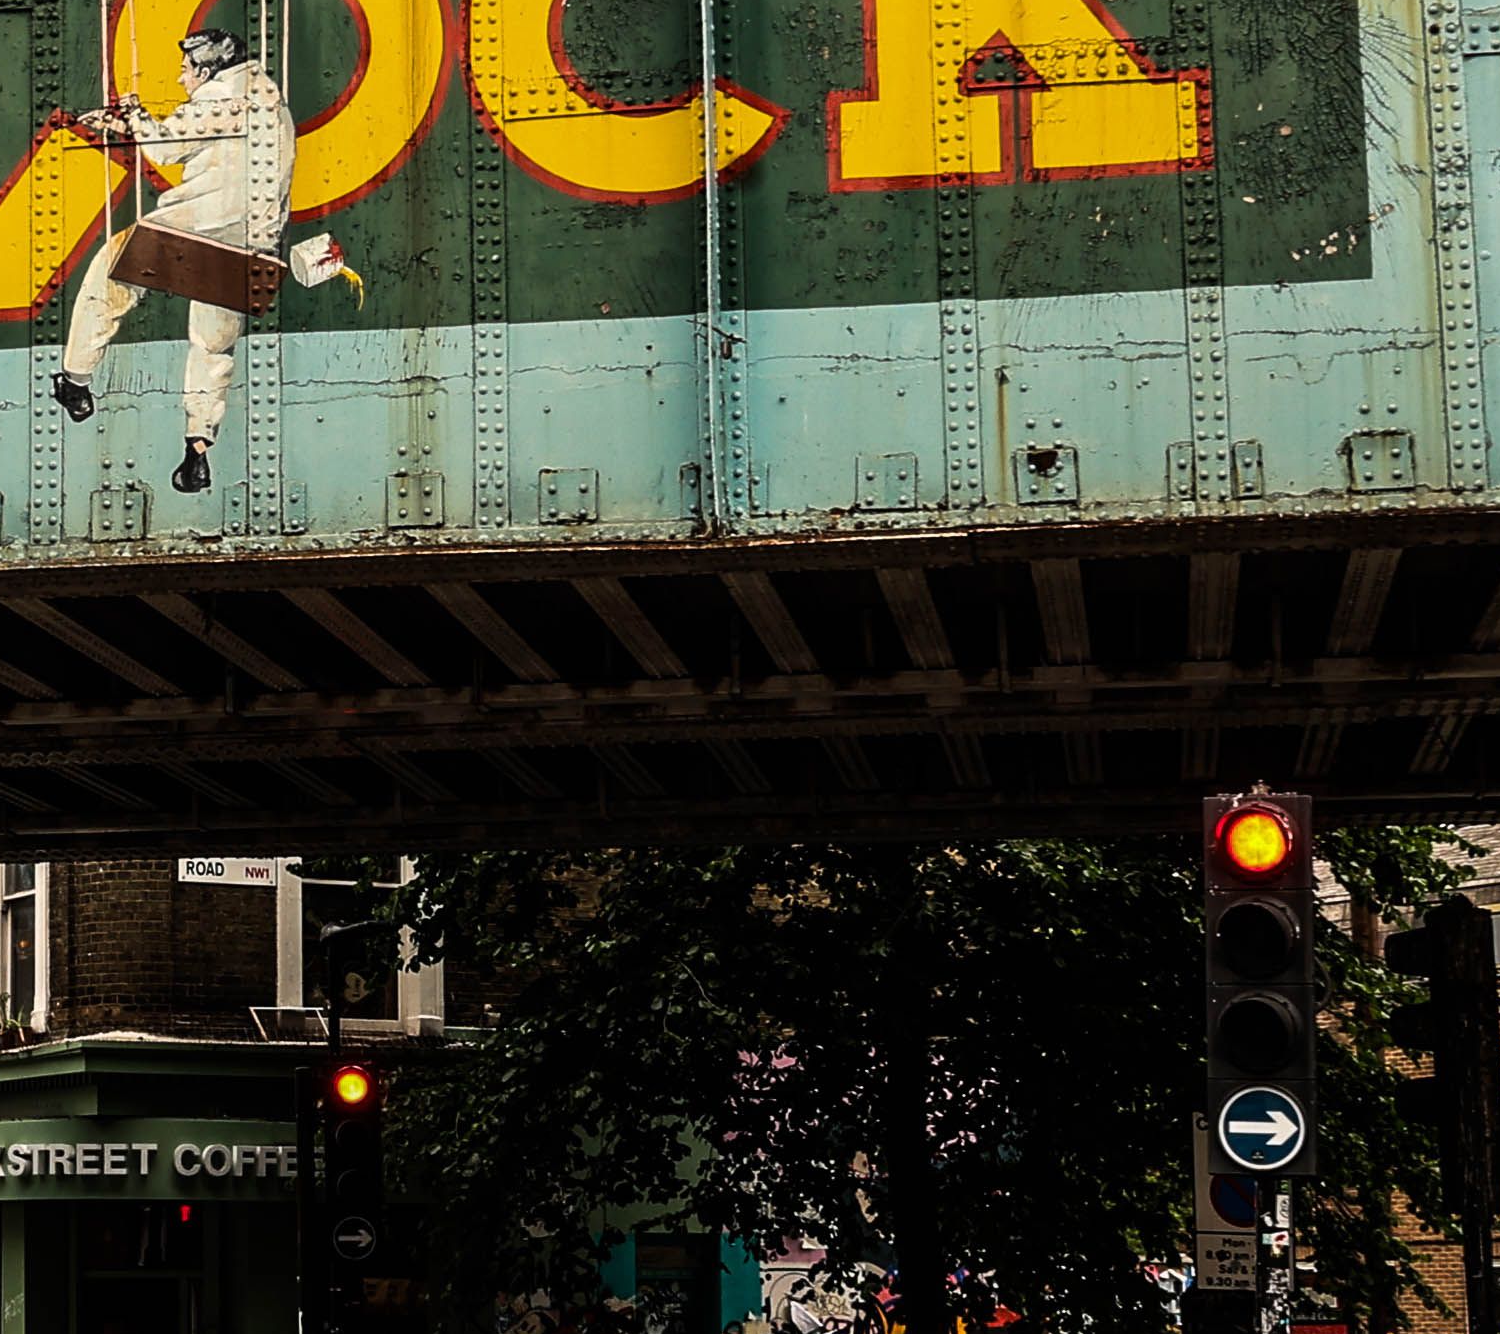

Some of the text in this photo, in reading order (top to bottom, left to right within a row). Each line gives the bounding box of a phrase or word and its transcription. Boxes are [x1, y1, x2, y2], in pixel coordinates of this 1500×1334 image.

[186, 861, 270, 880] ROAD NW1
[6, 1143, 158, 1177] STREET
